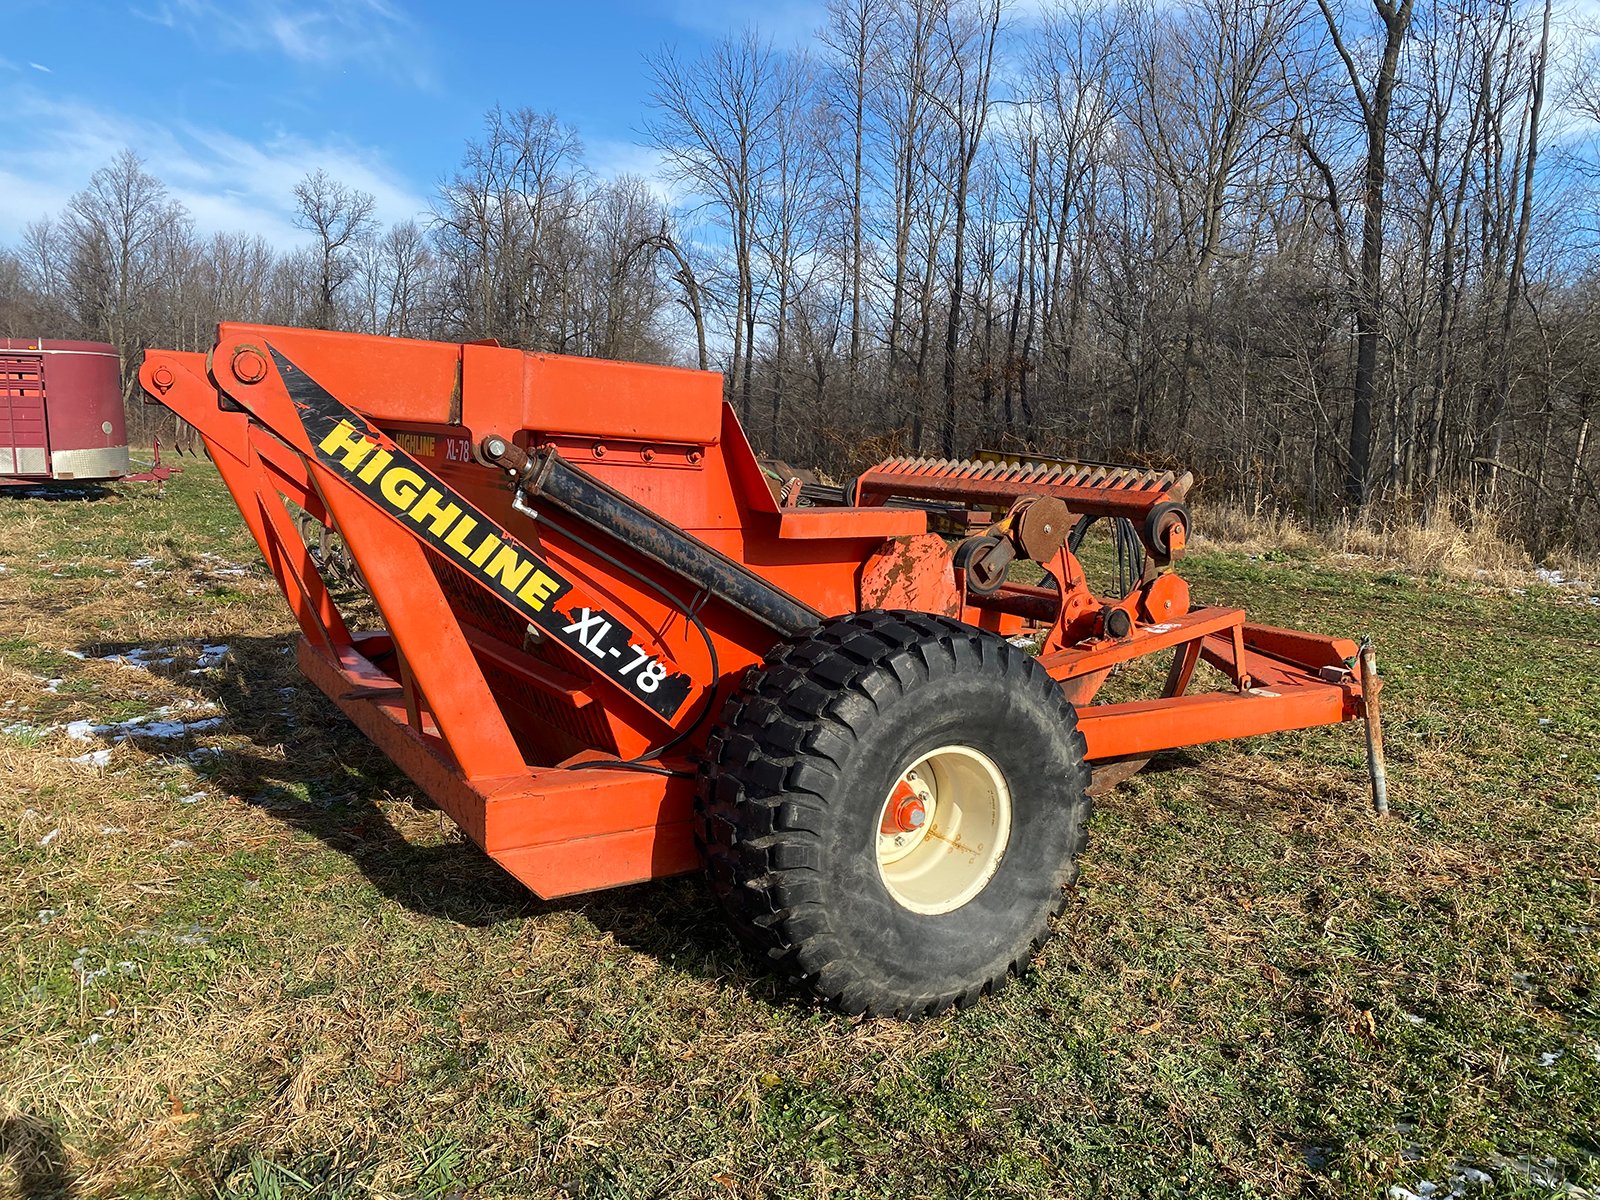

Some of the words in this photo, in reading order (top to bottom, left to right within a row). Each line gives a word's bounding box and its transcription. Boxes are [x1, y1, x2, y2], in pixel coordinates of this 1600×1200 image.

[446, 438, 469, 462] XL-78
[318, 418, 561, 612] HIGHLINE
[562, 607, 667, 694] XL-78
